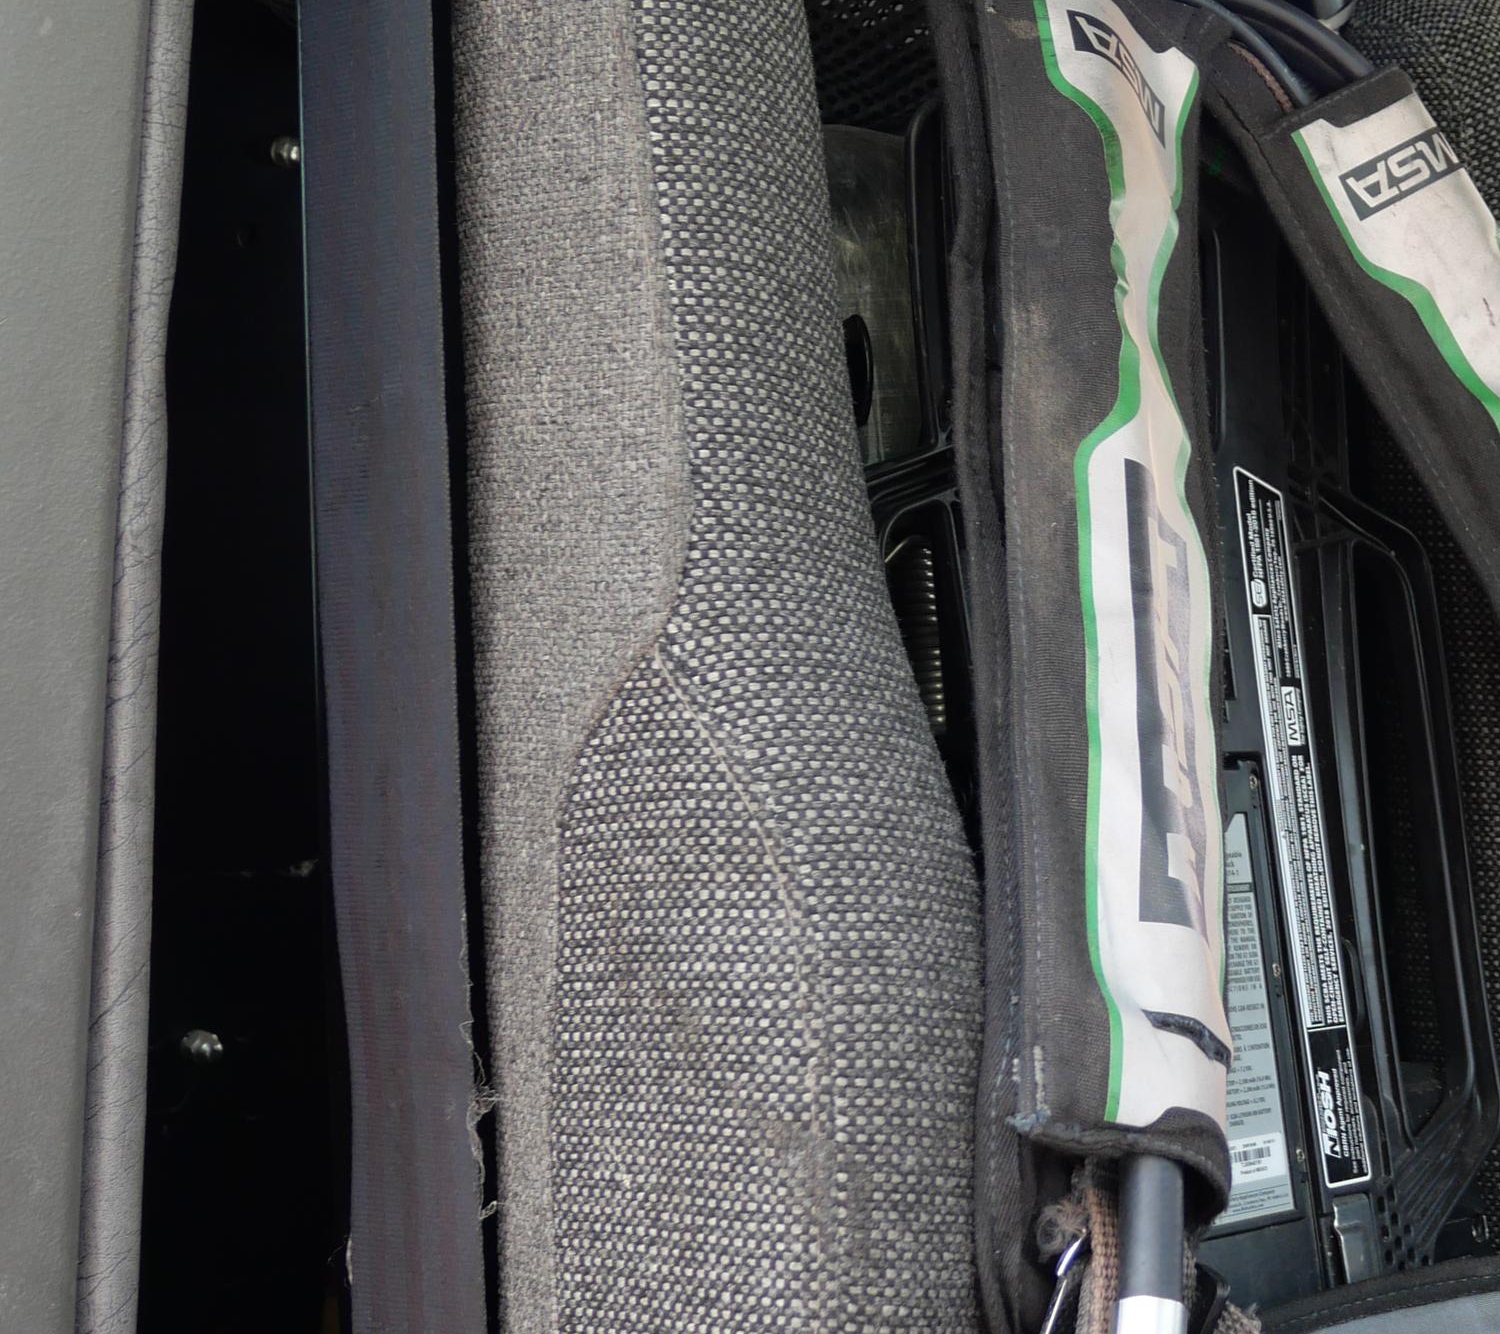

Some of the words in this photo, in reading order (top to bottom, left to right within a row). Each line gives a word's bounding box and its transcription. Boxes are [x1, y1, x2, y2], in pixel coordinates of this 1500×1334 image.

[1073, 14, 1165, 136] MSA
[1245, 512, 1254, 539] Model
[1248, 541, 1259, 577] Certified
[1283, 690, 1298, 740] MSA
[1291, 754, 1298, 767] ON
[1297, 754, 1305, 771] FOR
[1293, 769, 1304, 811] STANDARD
[1303, 803, 1315, 849] APPARATUS
[1310, 808, 1320, 841] REMOVE
[1302, 837, 1310, 858] NFPA
[1305, 860, 1312, 871] OF
[1310, 851, 1321, 896] BREATHING
[1317, 860, 1323, 871] DO
[1306, 873, 1320, 934] REQUIREMENTS
[1323, 910, 1331, 929] 2018
[1318, 954, 1326, 979] MEETS
[1321, 982, 1329, 1002] SCBA
[1332, 974, 1344, 1022] EMERGENCY
[1318, 1070, 1342, 1159] NIOSH
